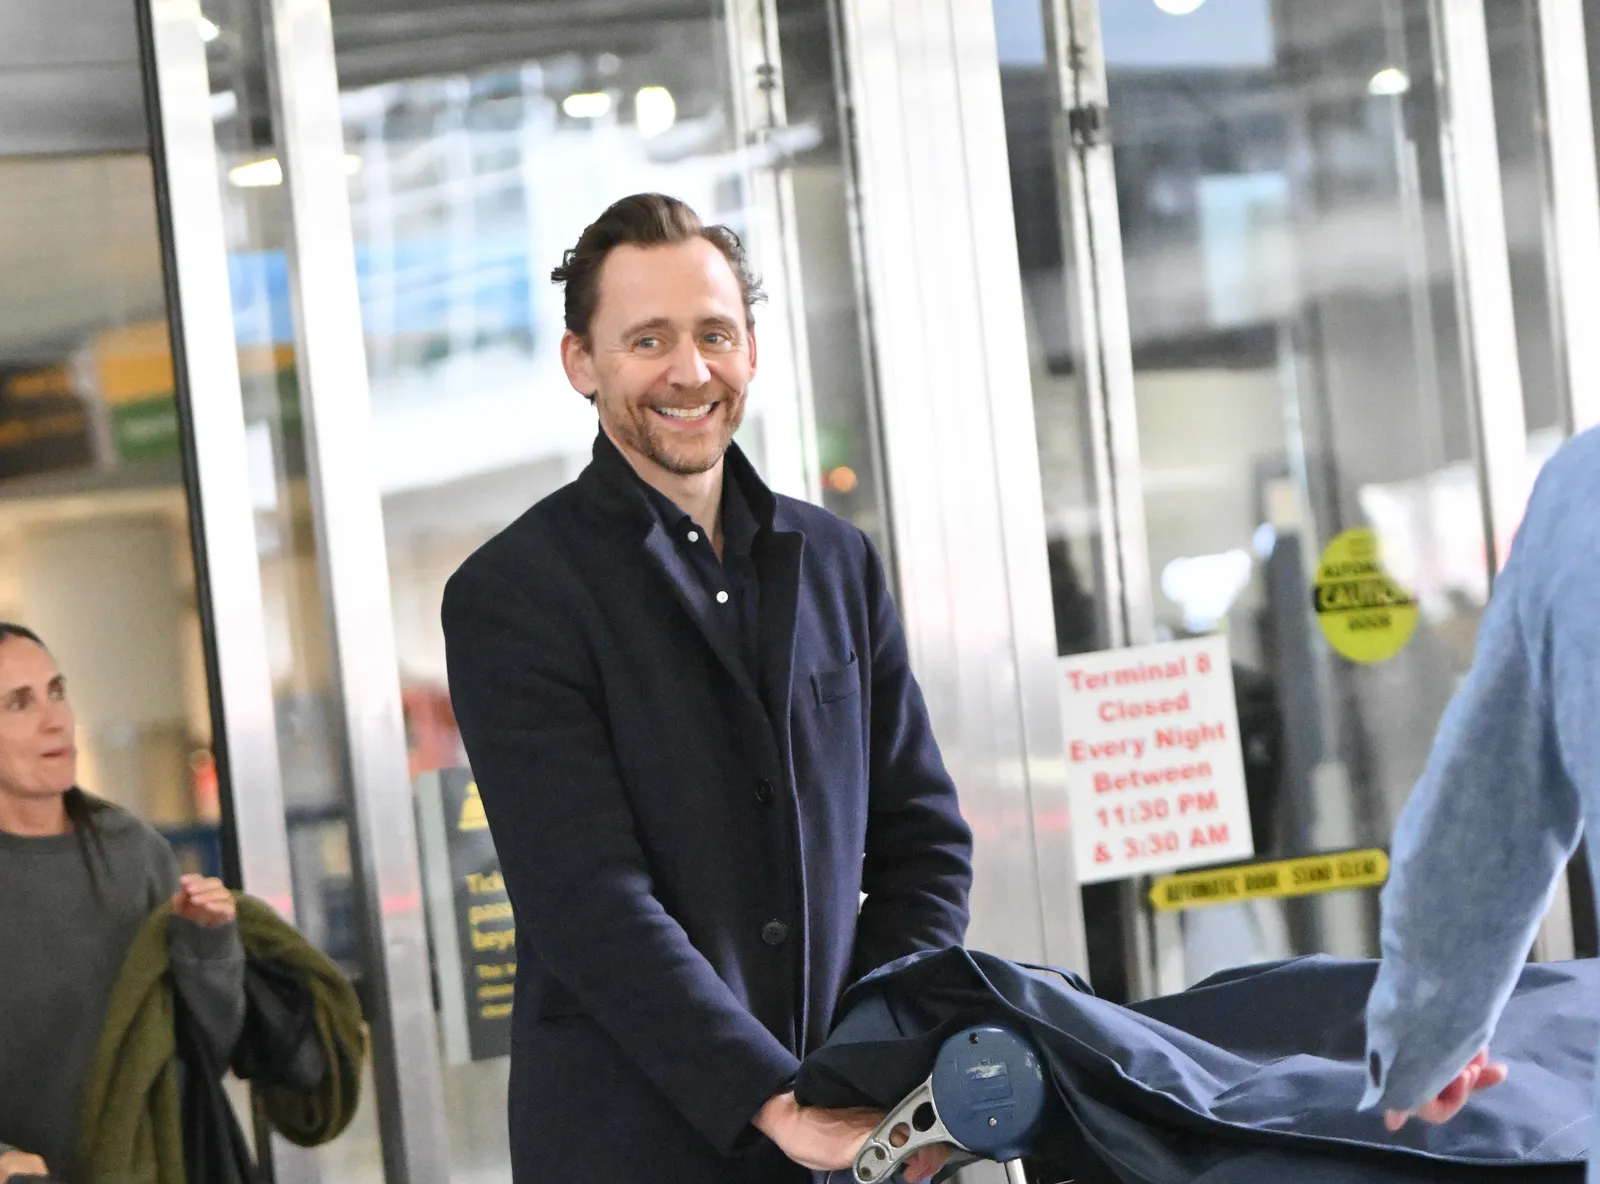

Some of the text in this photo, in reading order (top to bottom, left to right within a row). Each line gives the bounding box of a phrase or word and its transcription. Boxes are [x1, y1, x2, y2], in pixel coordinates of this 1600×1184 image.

[1066, 652, 1211, 691] Terminal 8
[1098, 690, 1191, 723] Closed
[1069, 721, 1226, 763] Every Night
[1093, 761, 1212, 794] Between
[1096, 790, 1218, 828] 11:30 PM
[1093, 823, 1229, 864] & 3:30 AM
